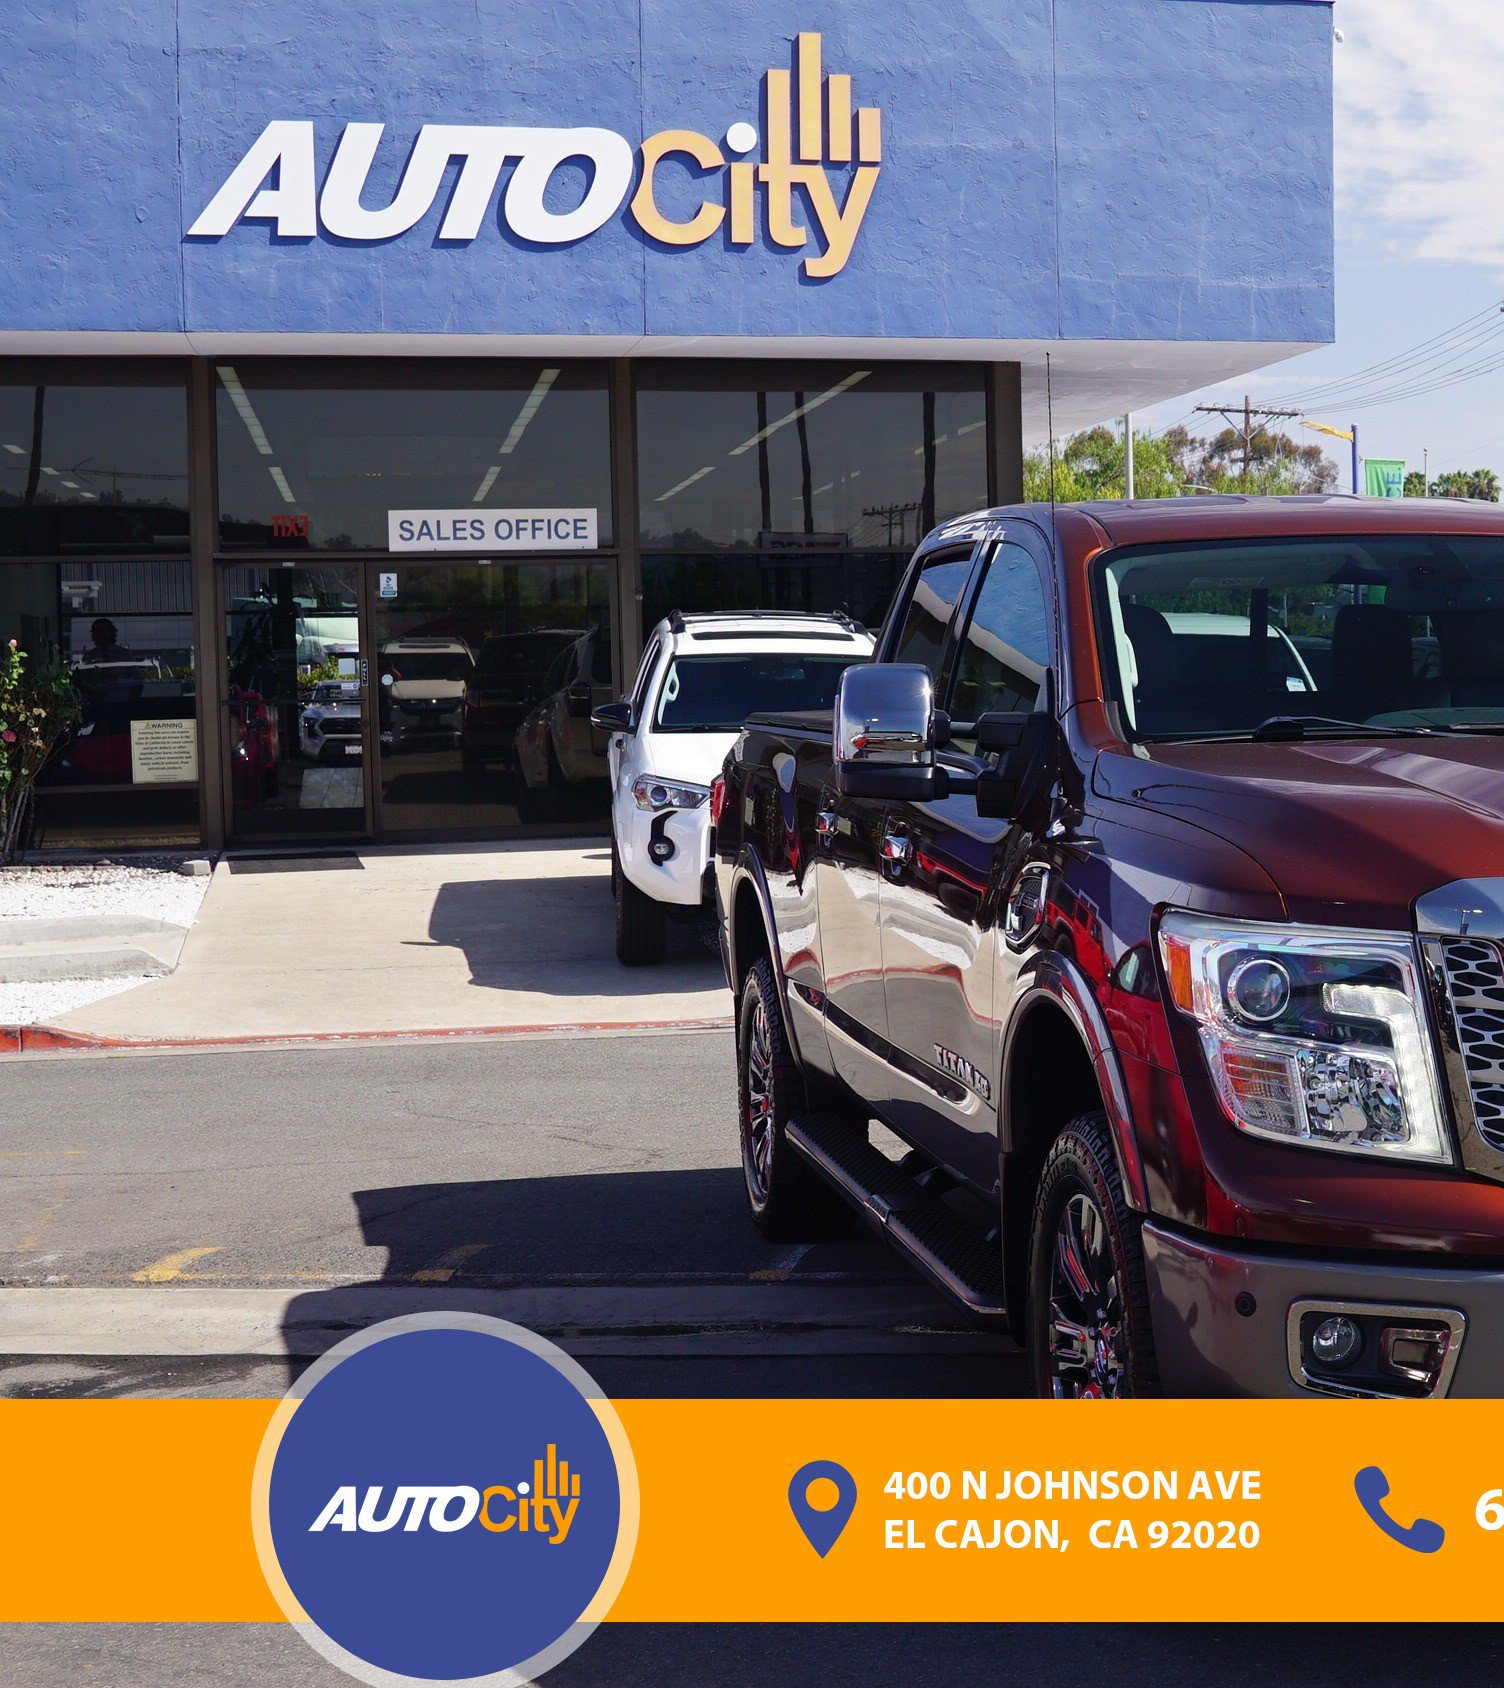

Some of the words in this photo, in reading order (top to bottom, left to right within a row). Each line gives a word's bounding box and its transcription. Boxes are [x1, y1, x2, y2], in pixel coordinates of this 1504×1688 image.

[187, 33, 882, 279] AUTOCity
[398, 520, 486, 541] SALES
[494, 518, 589, 540] OFFICE
[933, 1042, 975, 1087] TITAN
